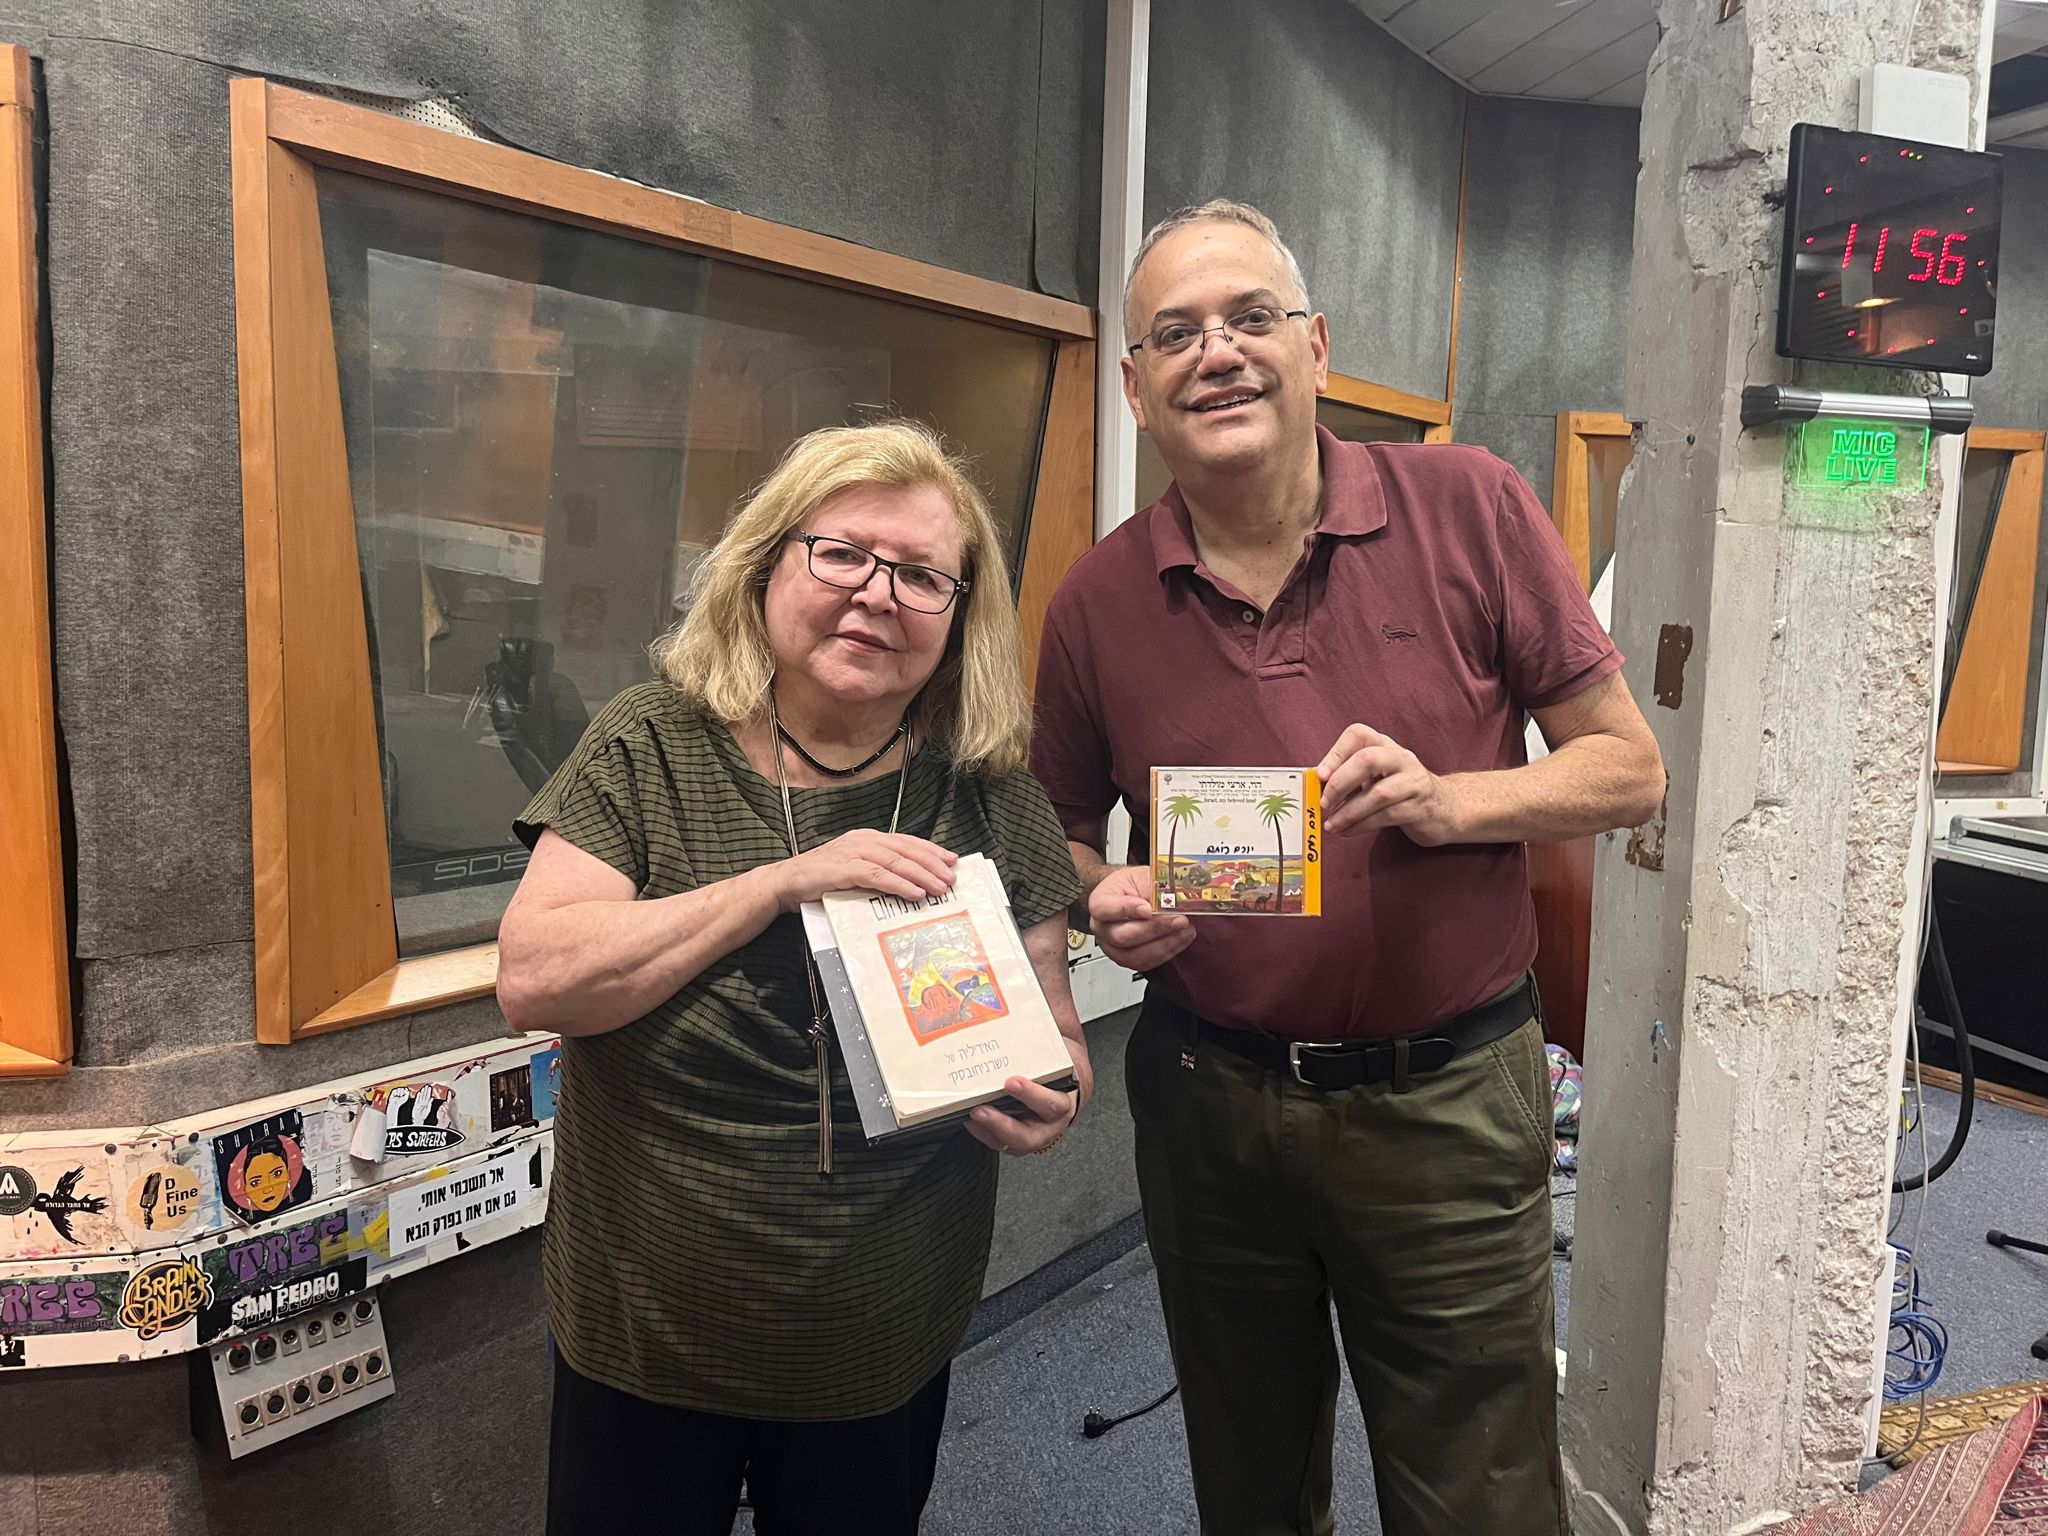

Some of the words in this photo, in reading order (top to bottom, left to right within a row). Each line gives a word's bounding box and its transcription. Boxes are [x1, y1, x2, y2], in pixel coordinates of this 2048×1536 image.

[1831, 429, 1896, 457] MIC
[1824, 456, 1897, 483] LIVE
[957, 1039, 1000, 1060] האידיליה
[948, 1055, 1009, 1086] טשרניחובסקי
[217, 1111, 300, 1154] SHIRAN
[386, 1131, 404, 1148] PS
[165, 1178, 176, 1190] D
[449, 1173, 487, 1198] תשכחי
[489, 1166, 505, 1185] אל
[166, 1187, 199, 1204] Fine
[485, 1195, 501, 1215] אם
[504, 1190, 517, 1208] גם
[167, 1205, 187, 1218] Us
[433, 1209, 463, 1236] בפרק
[465, 1202, 482, 1222] את
[405, 1220, 430, 1243] הבא
[133, 1256, 203, 1302] BRAIN
[231, 1291, 273, 1321] SAN
[276, 1271, 340, 1309] PEDRO
